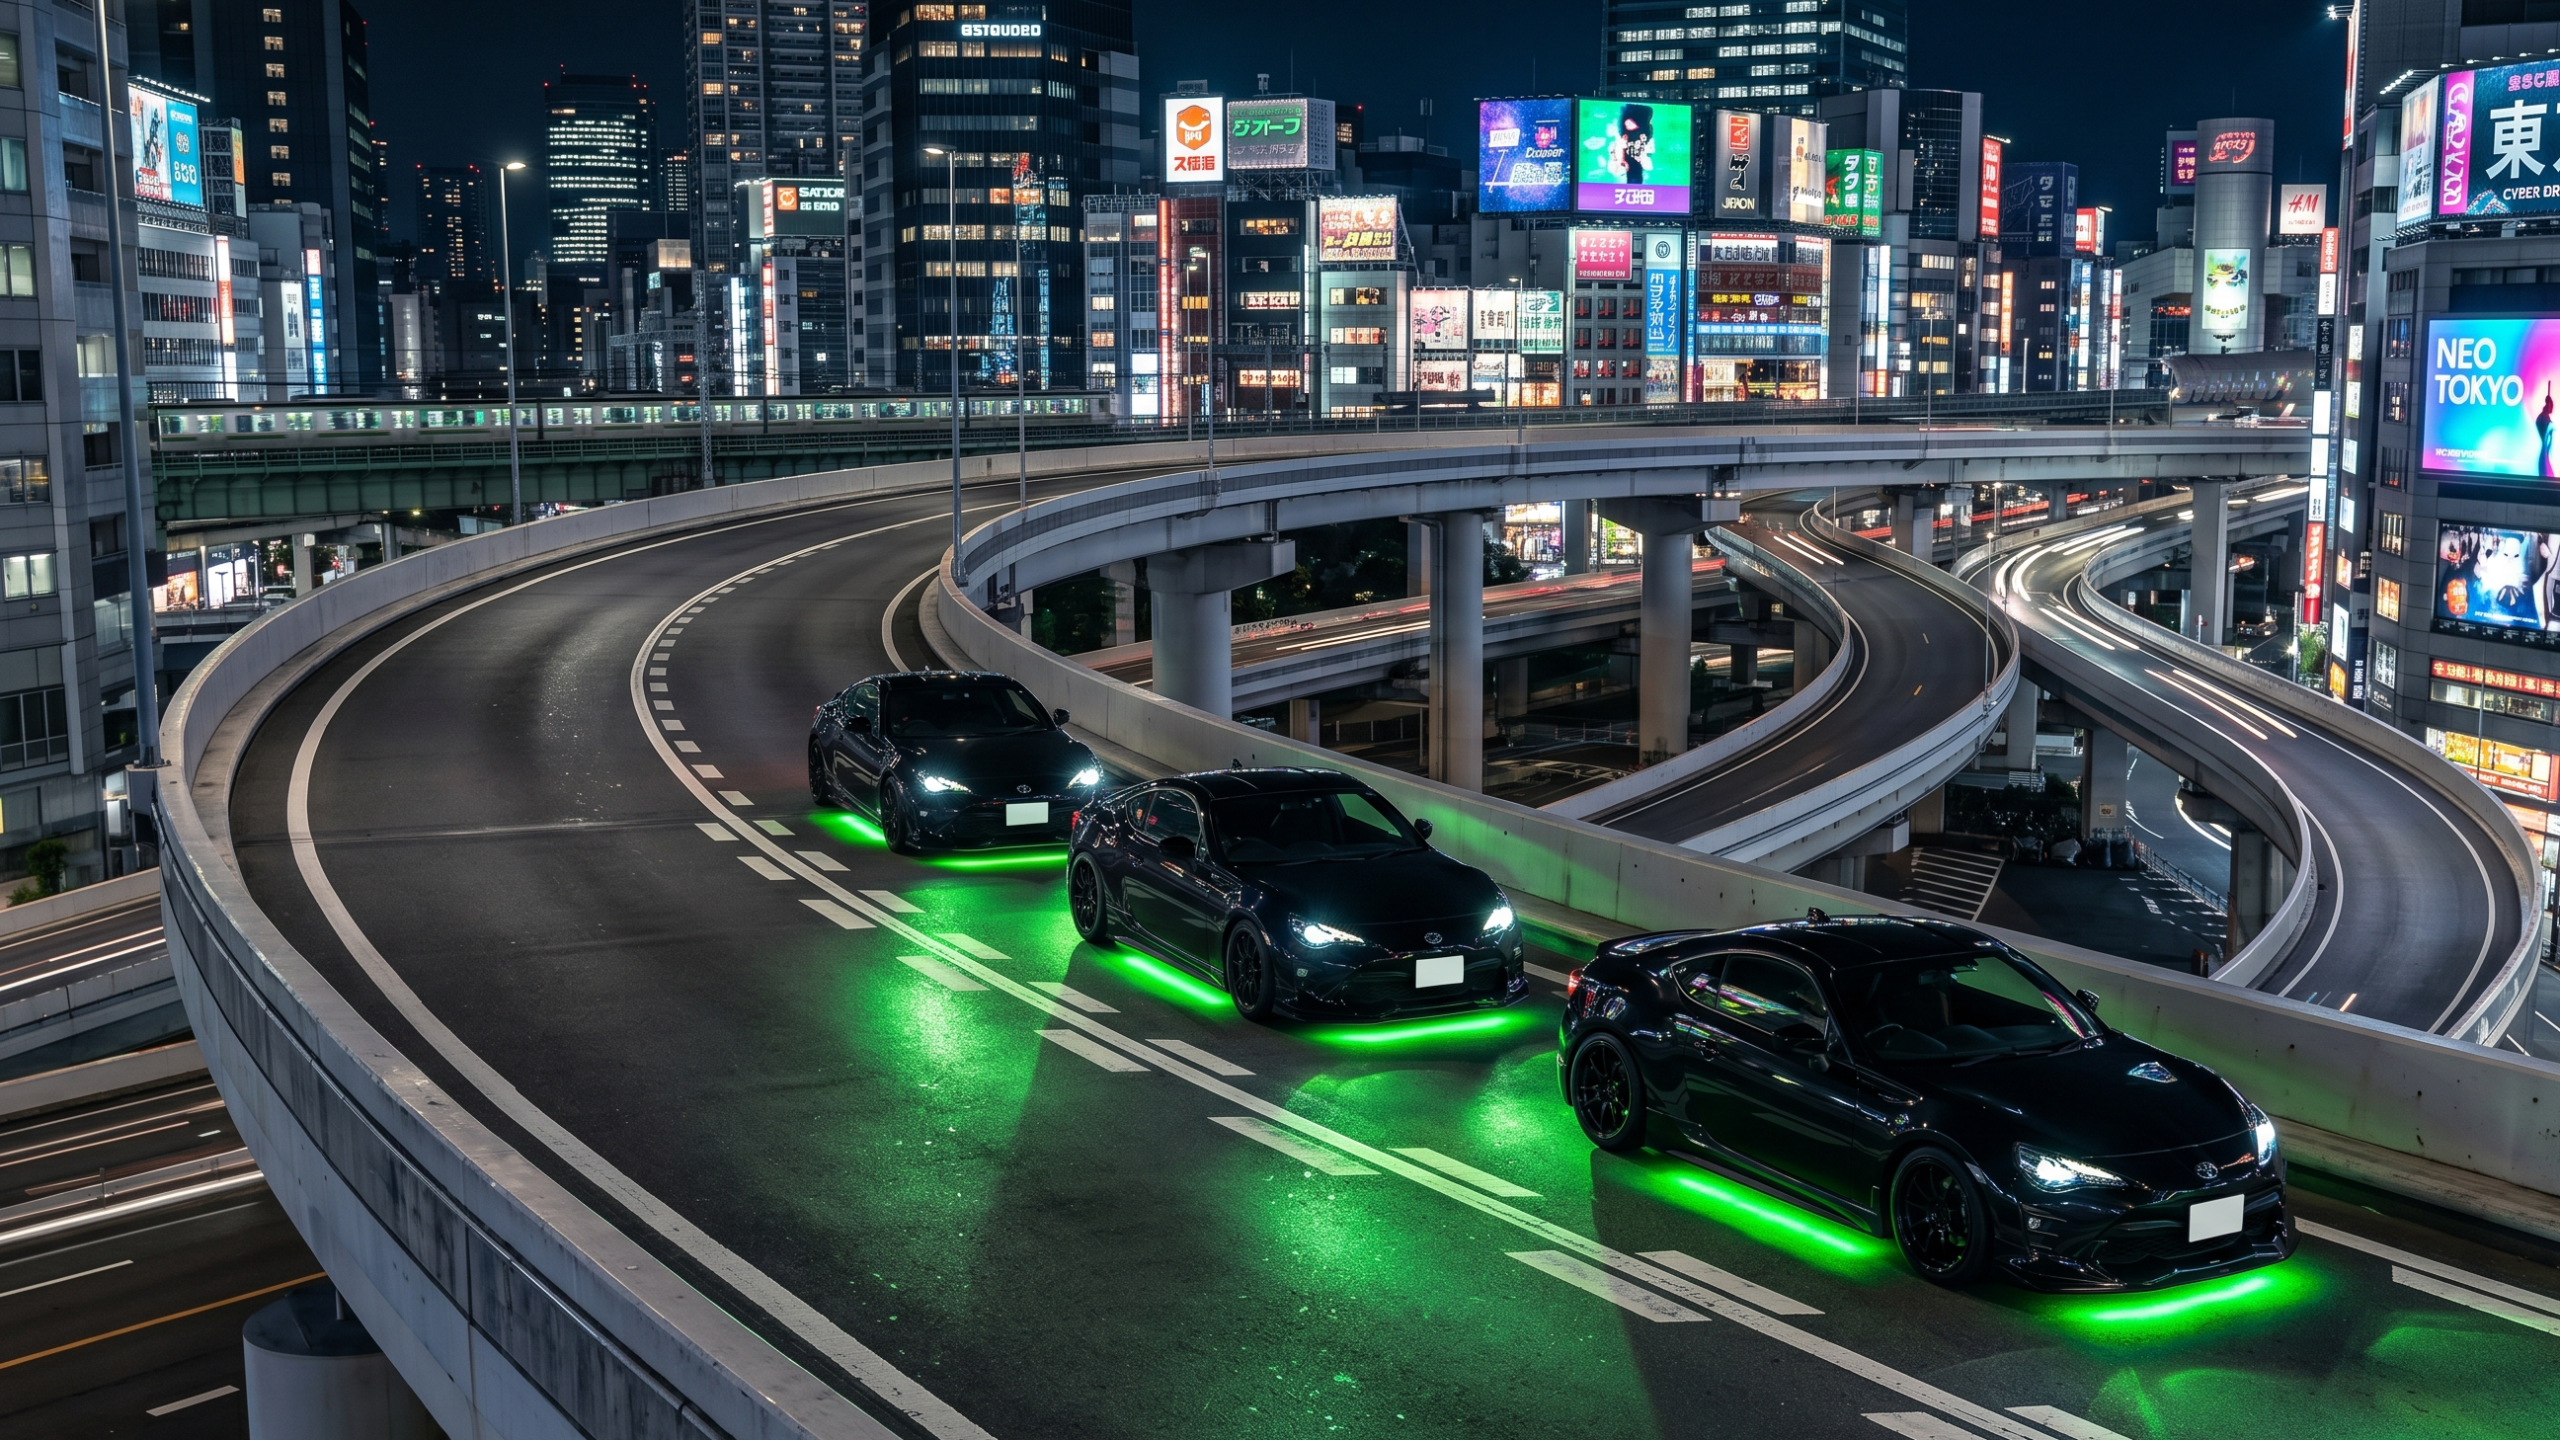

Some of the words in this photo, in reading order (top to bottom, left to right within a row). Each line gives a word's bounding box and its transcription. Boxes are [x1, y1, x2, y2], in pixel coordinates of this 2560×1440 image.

[2485, 99, 2560, 180] 東
[2503, 186, 2540, 201] CYBER
[2436, 337, 2497, 370] NEO
[2435, 374, 2524, 407] TOKYO
